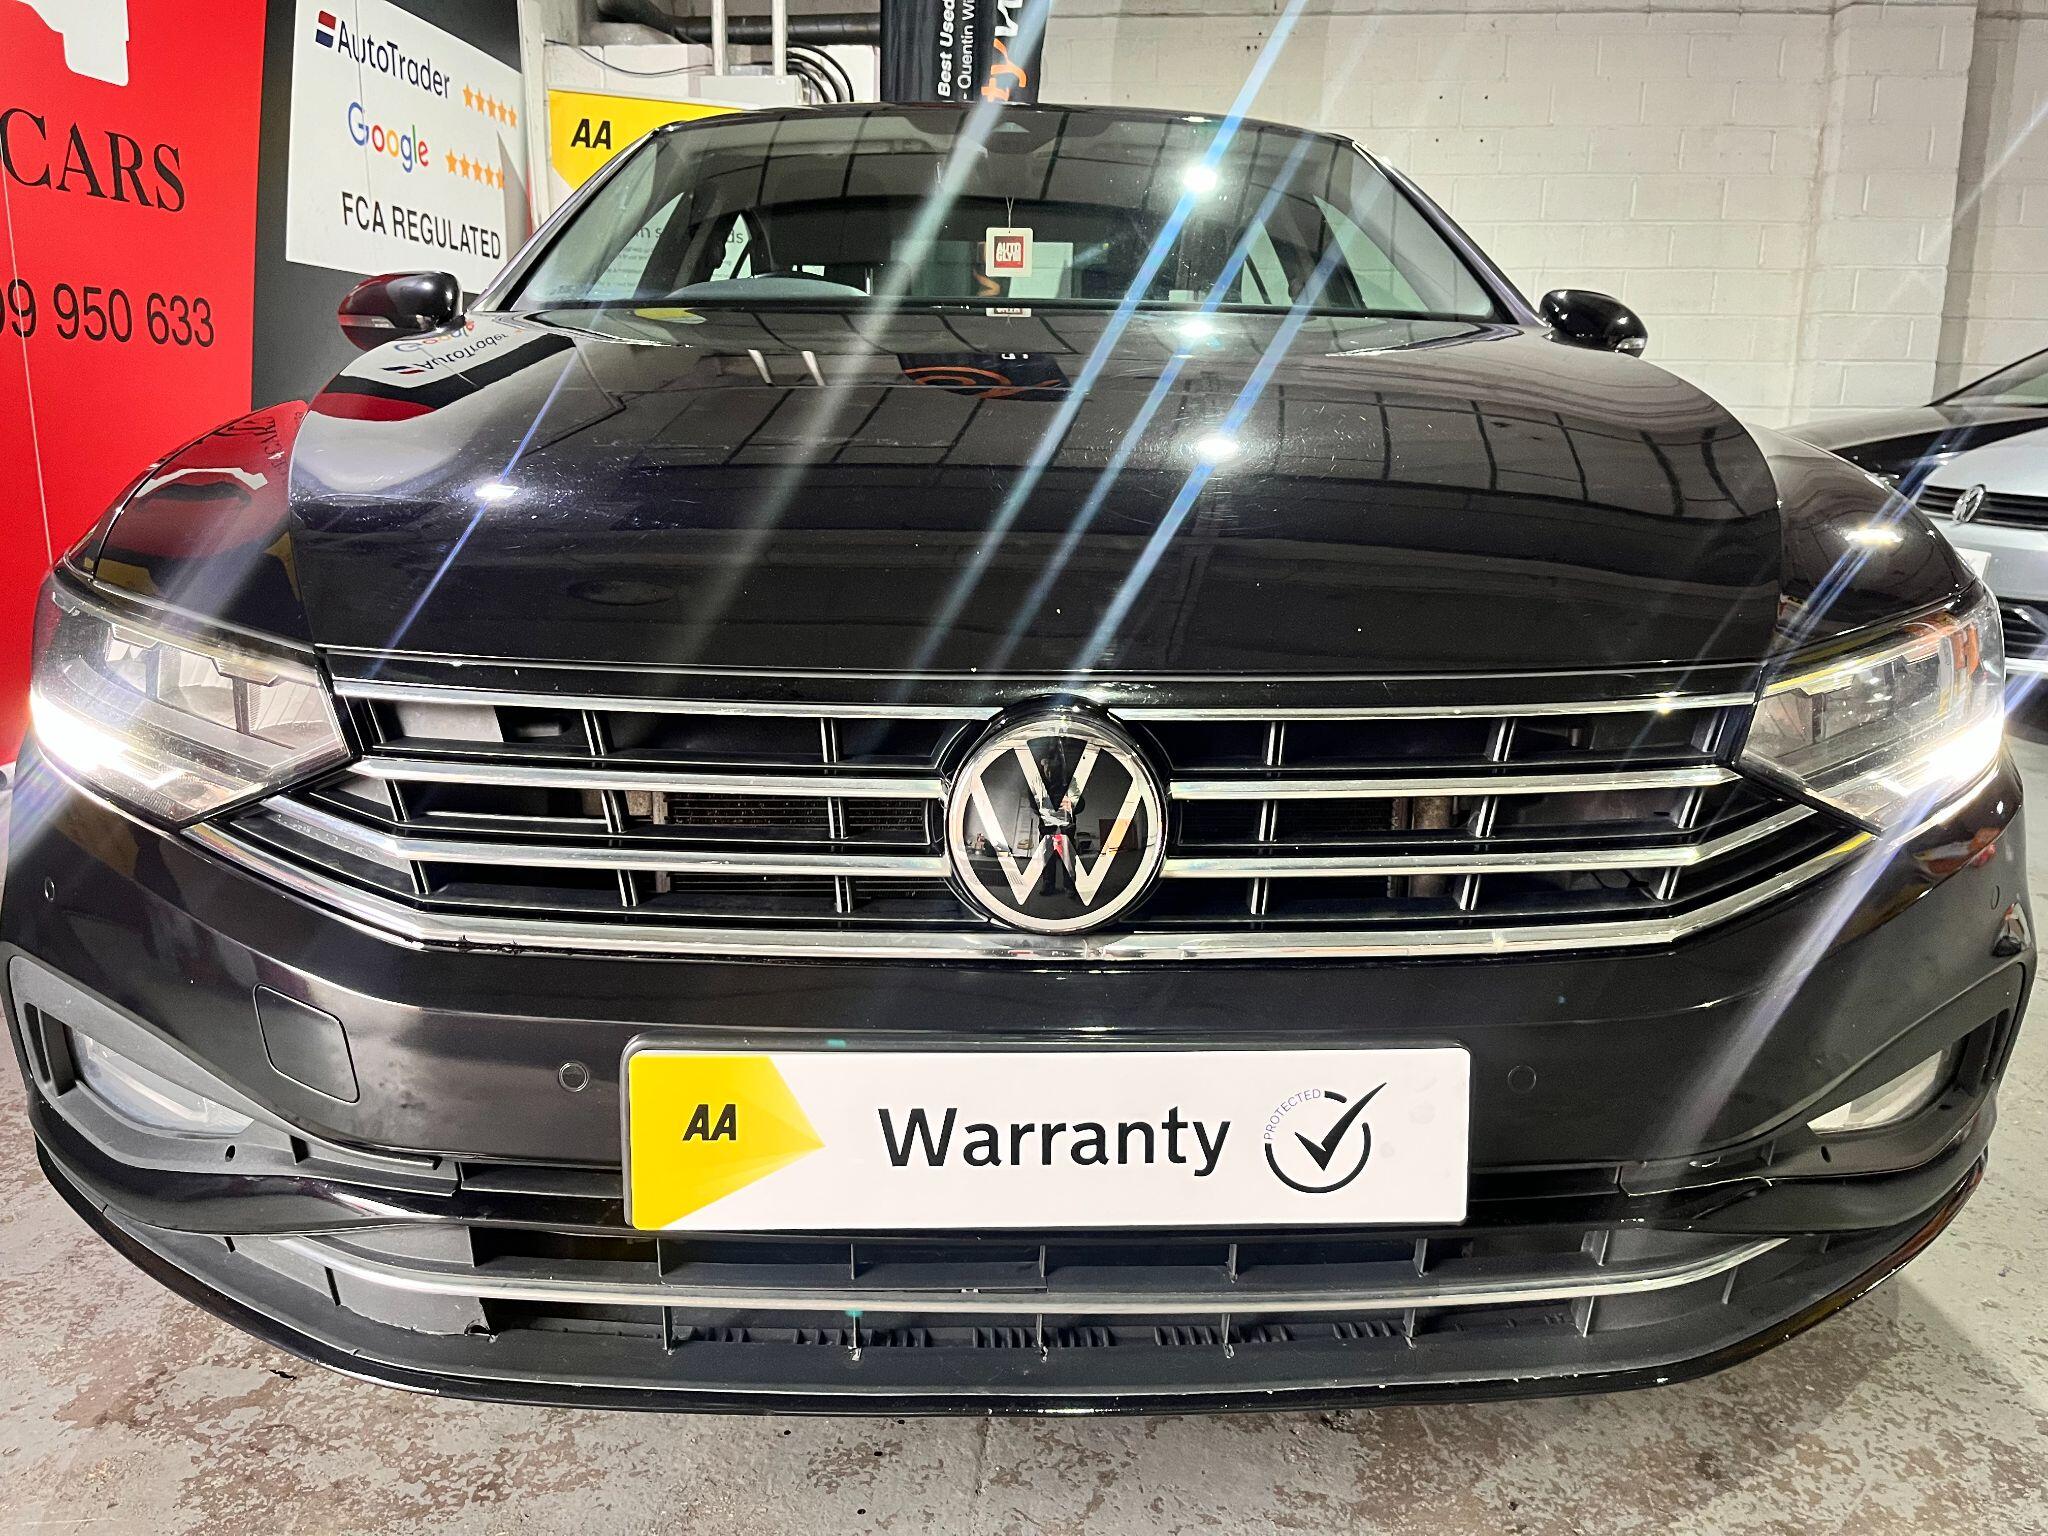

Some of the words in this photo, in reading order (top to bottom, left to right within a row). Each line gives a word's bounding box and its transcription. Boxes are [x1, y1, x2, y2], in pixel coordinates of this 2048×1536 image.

[337, 20, 450, 99] AutoTrader
[937, 51, 953, 97] Best
[957, 24, 974, 89] Quentin
[0, 107, 186, 212] CARS
[348, 101, 429, 173] Google
[570, 118, 612, 150] AA
[341, 191, 388, 235] FCA
[392, 205, 501, 260] REGULATED
[53, 283, 133, 343] 950
[146, 292, 214, 348] 633
[682, 1102, 738, 1142] AA
[878, 1105, 1232, 1178] Warranty
[1263, 1088, 1321, 1141] PROTECTED
